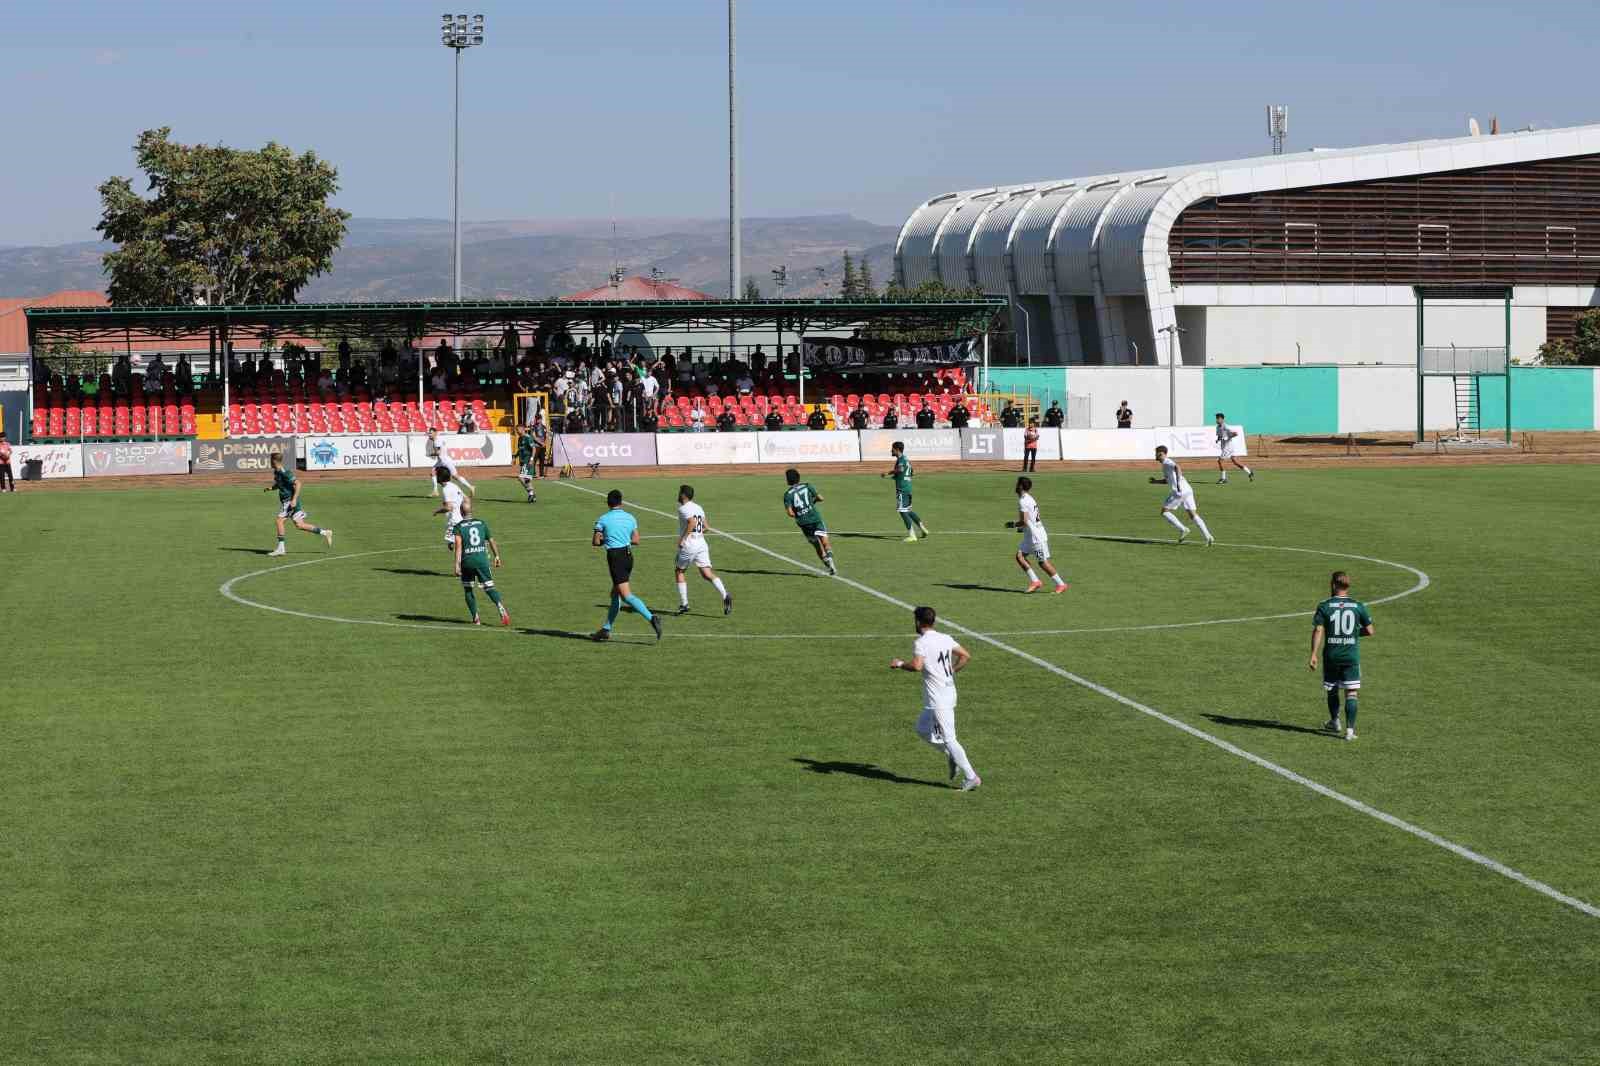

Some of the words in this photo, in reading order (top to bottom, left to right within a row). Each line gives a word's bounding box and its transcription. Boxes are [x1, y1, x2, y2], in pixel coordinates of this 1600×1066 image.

[353, 438, 393, 450] CUNDA
[583, 443, 632, 457] cata
[236, 457, 278, 469] GRU
[343, 452, 404, 466] DENİZCİLİK
[793, 487, 810, 508] 47
[469, 527, 480, 546] 8
[1329, 609, 1355, 635] 10
[937, 650, 952, 677] 11
